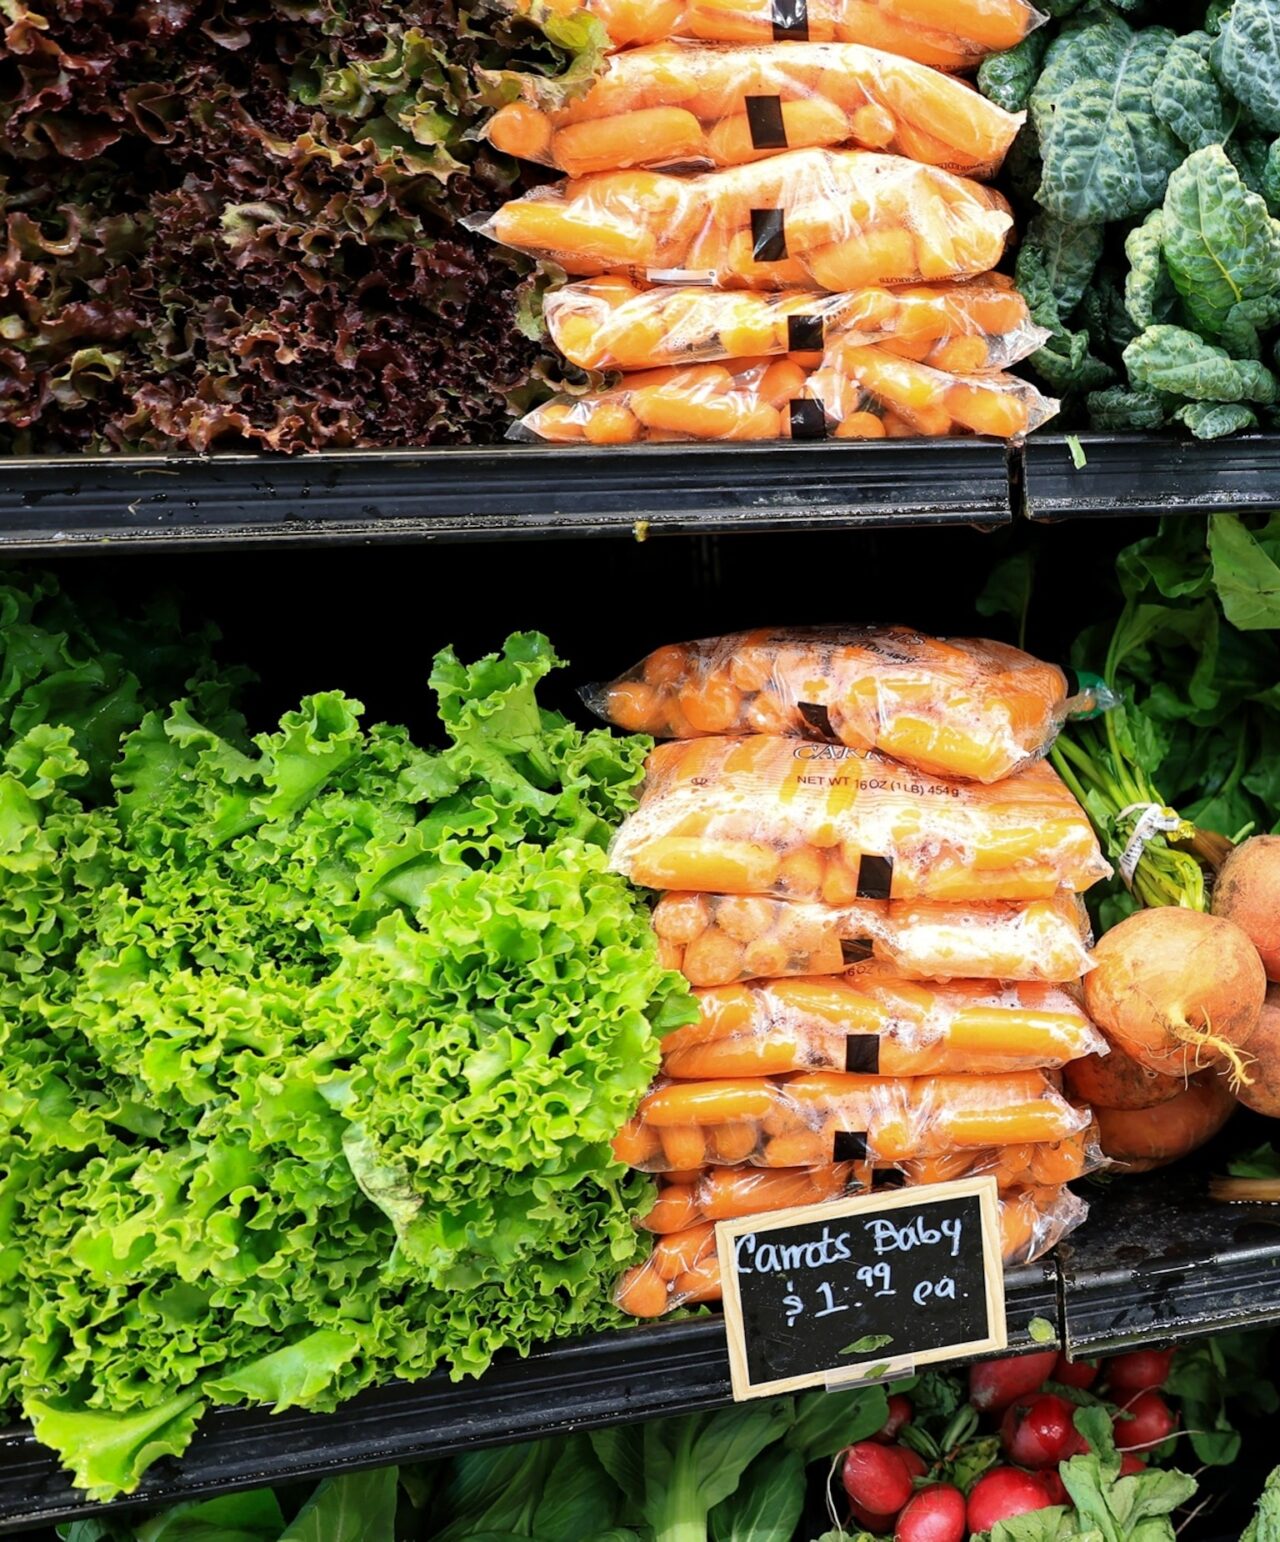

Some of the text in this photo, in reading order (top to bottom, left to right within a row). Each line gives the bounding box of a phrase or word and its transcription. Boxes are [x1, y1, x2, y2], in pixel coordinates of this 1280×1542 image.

[796, 775, 824, 786] NET
[828, 776, 850, 787] WT
[735, 1216, 962, 1274] Carrots Baby
